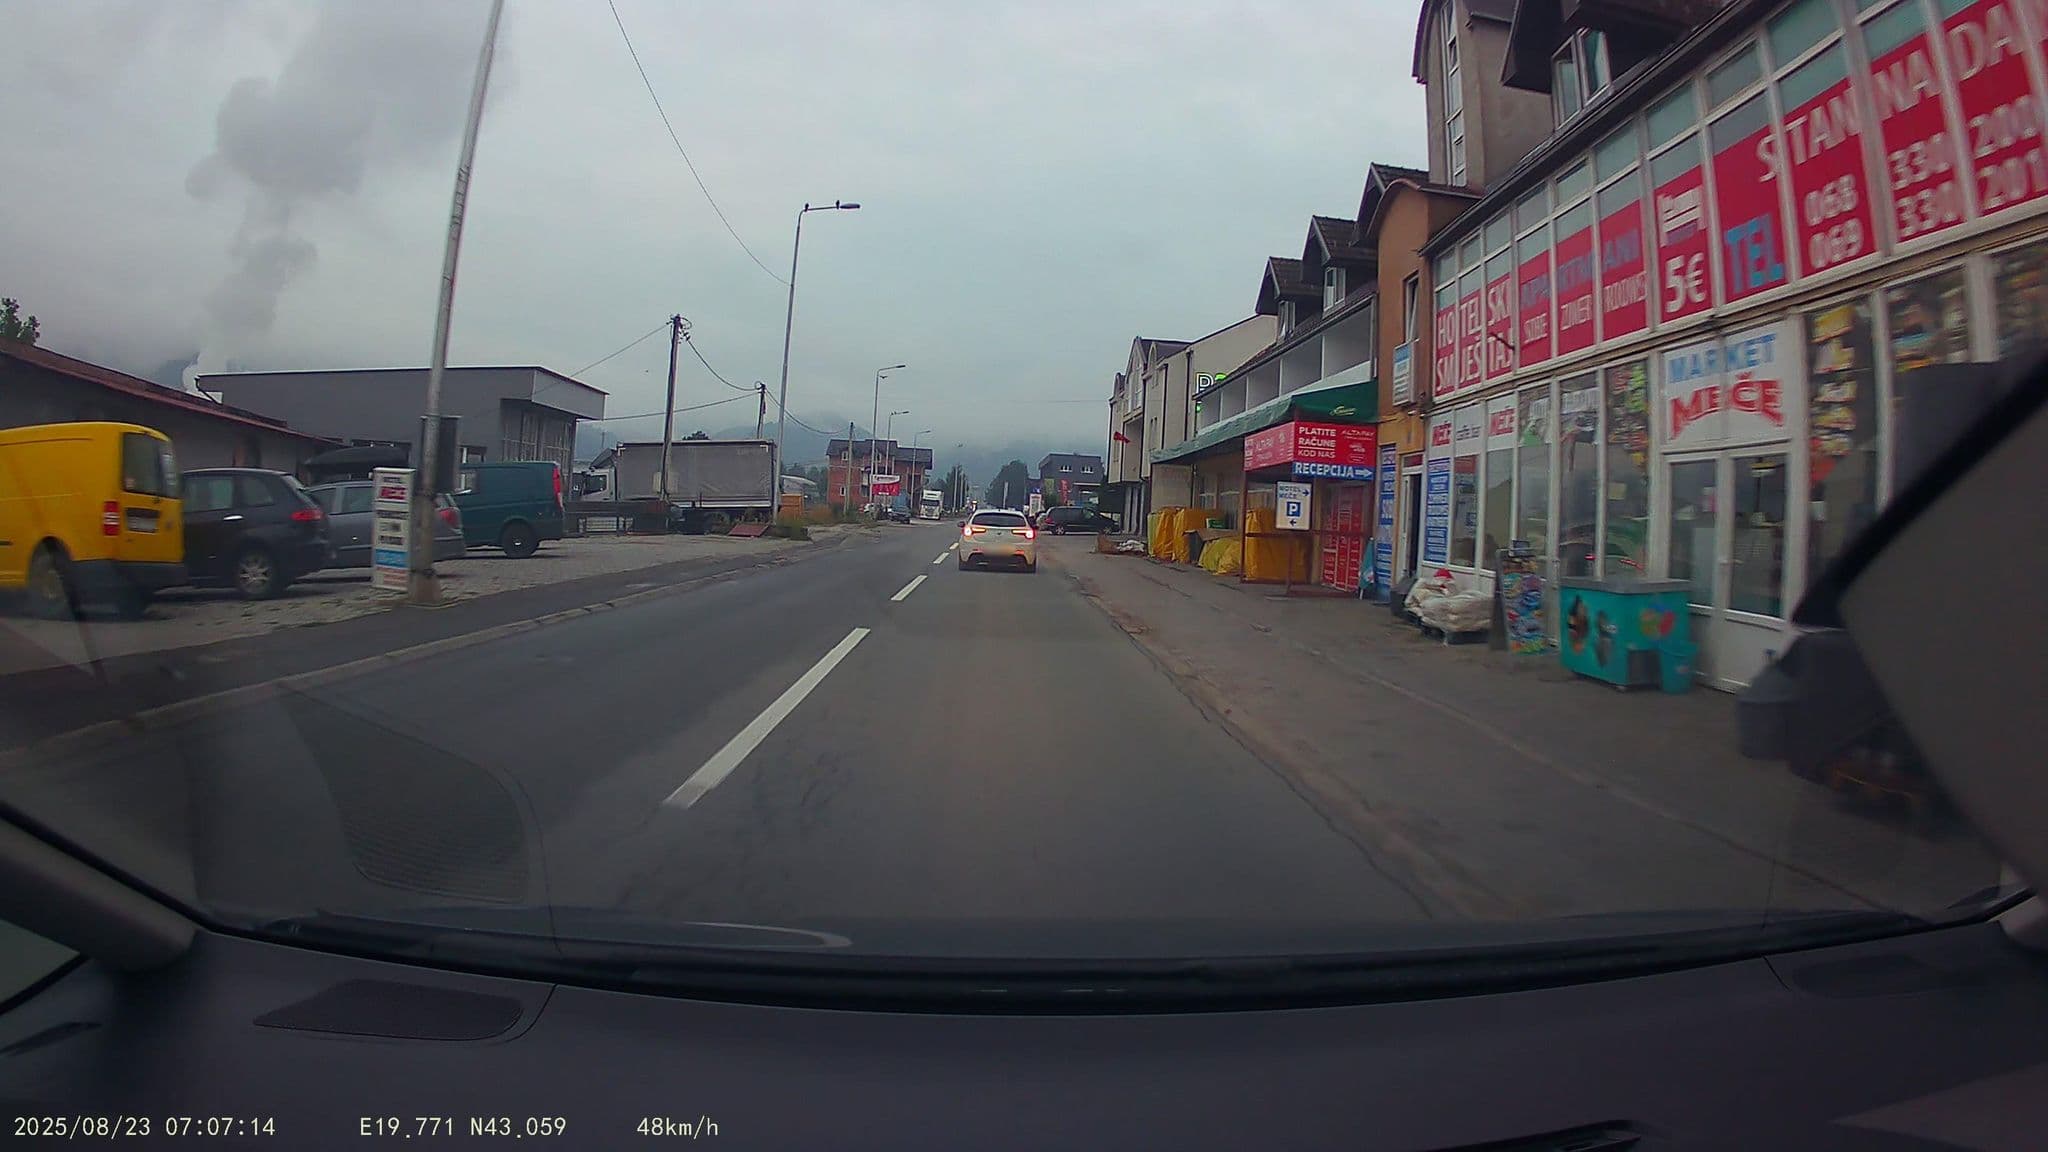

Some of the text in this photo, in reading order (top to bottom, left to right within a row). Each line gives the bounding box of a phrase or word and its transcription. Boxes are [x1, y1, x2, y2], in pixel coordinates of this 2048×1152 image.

[1666, 252, 1706, 313] 5€
[1668, 333, 1777, 383] MARKET
[1670, 372, 1785, 440] MEČE
[1299, 426, 1337, 437] PLATITE
[1298, 437, 1337, 448] RAČUNE
[1318, 450, 1336, 458] NAS
[1295, 462, 1354, 478] RECEPCIJA
